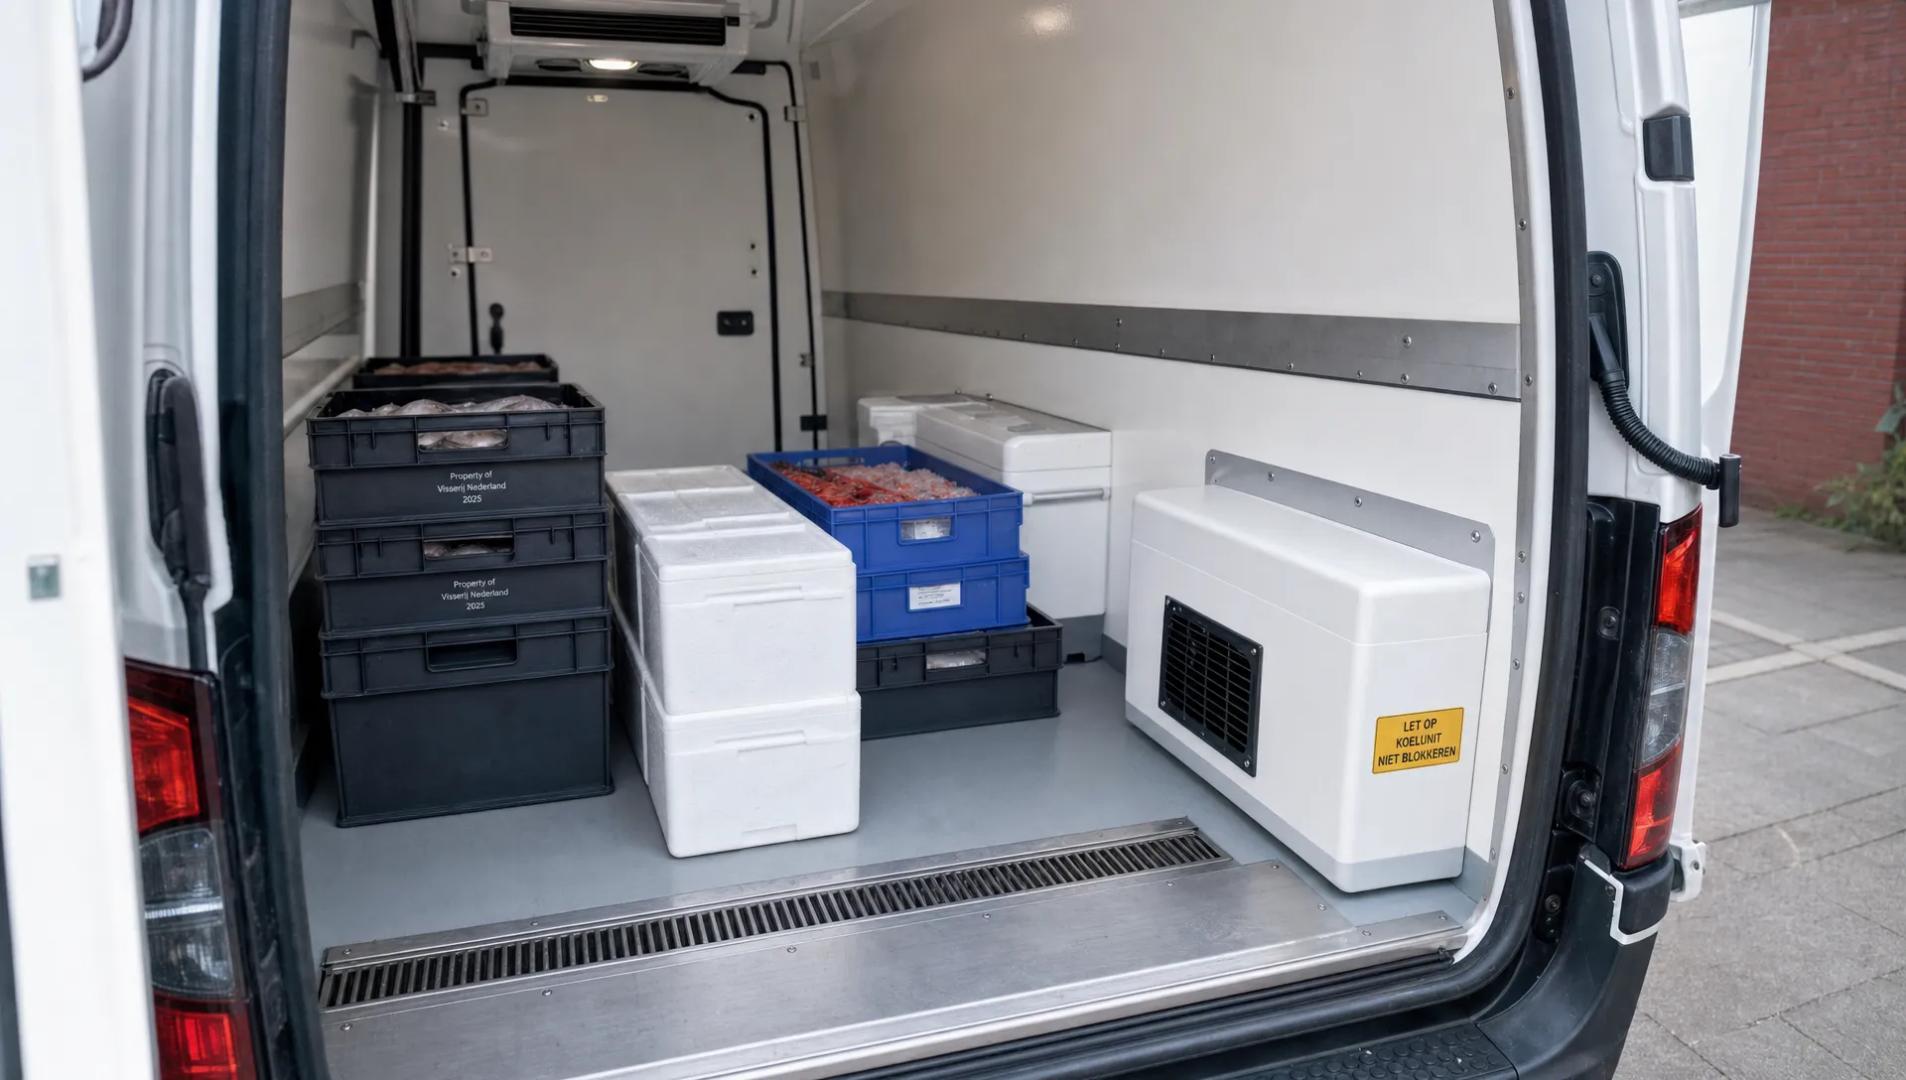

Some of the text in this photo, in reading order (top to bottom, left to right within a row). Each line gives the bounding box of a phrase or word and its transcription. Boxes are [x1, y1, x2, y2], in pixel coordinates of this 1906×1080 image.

[450, 470, 493, 480] Property of
[467, 481, 506, 491] Nederland
[463, 495, 482, 503] 2025
[453, 578, 496, 588] Property of
[470, 588, 509, 598] Nederland
[466, 601, 485, 610] 2025
[1403, 718, 1438, 732] LET OP
[1396, 733, 1442, 749] KOELUNIT
[1378, 746, 1456, 767] NIET BLOKKEREN
